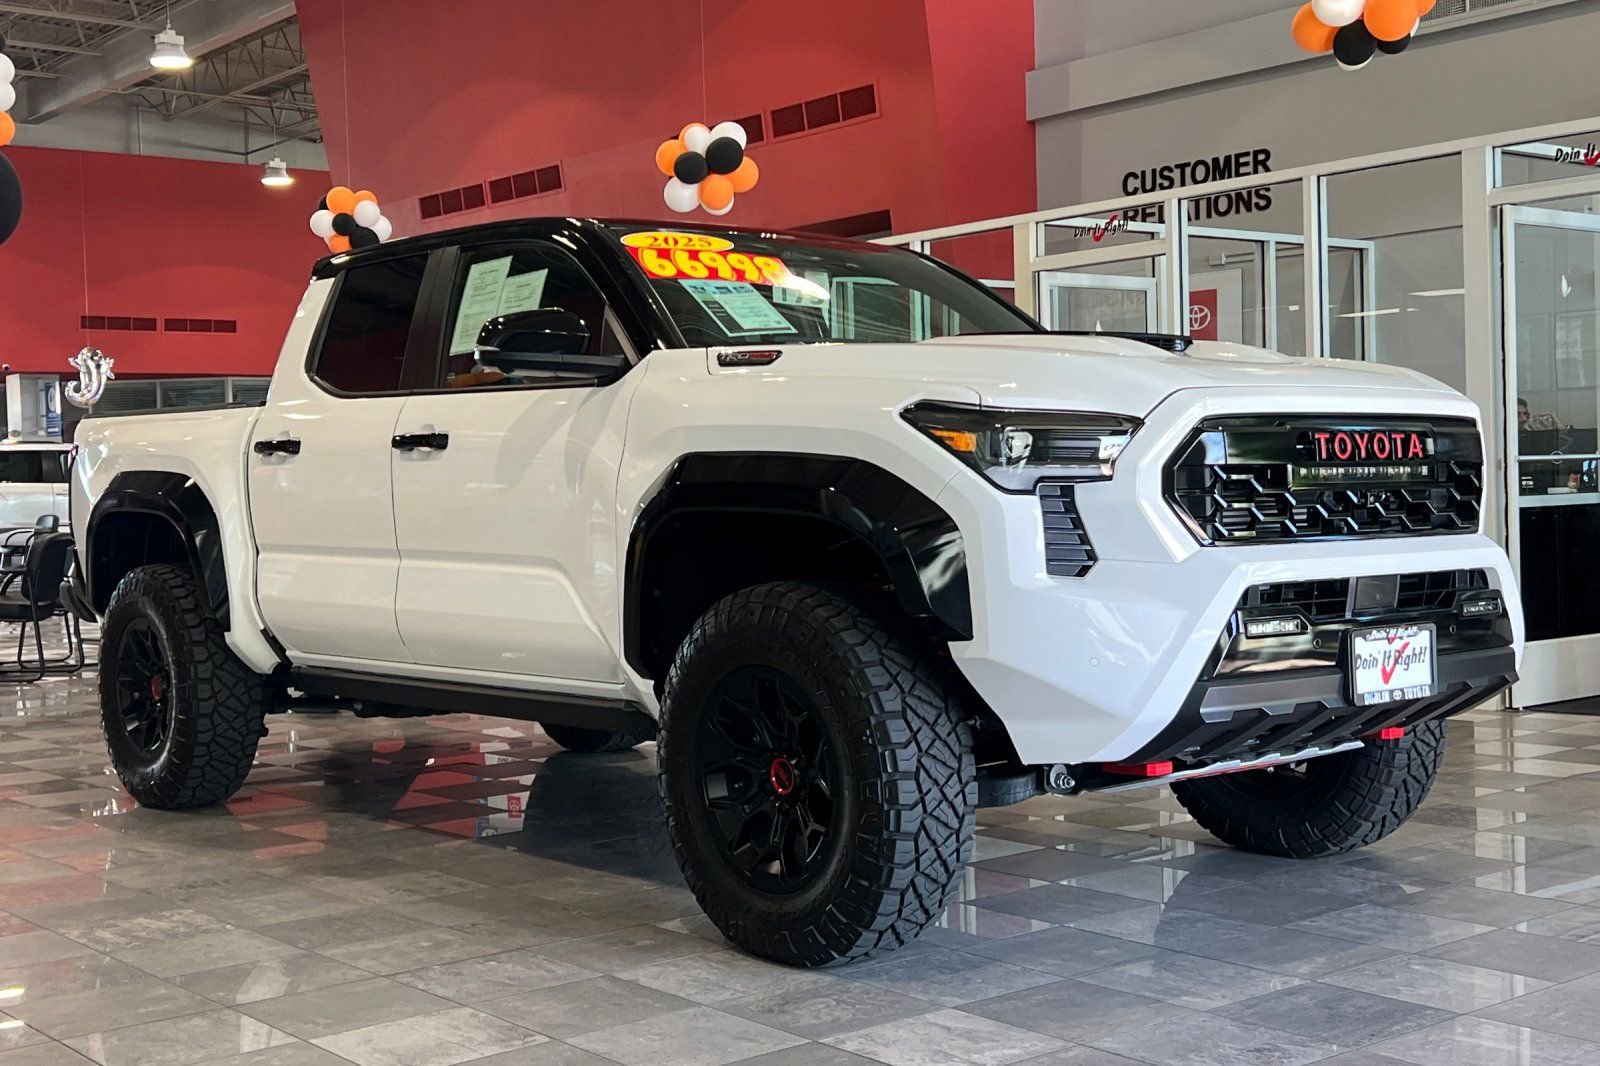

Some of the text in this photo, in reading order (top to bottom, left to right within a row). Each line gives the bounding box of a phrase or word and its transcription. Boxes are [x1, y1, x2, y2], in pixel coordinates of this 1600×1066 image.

[1122, 148, 1272, 197] CUSTOMER
[649, 235, 713, 248] 2025
[1315, 432, 1424, 460] TOYOTA
[1355, 646, 1428, 671] Doin' It Right!
[1404, 685, 1431, 700] TOYOTA
